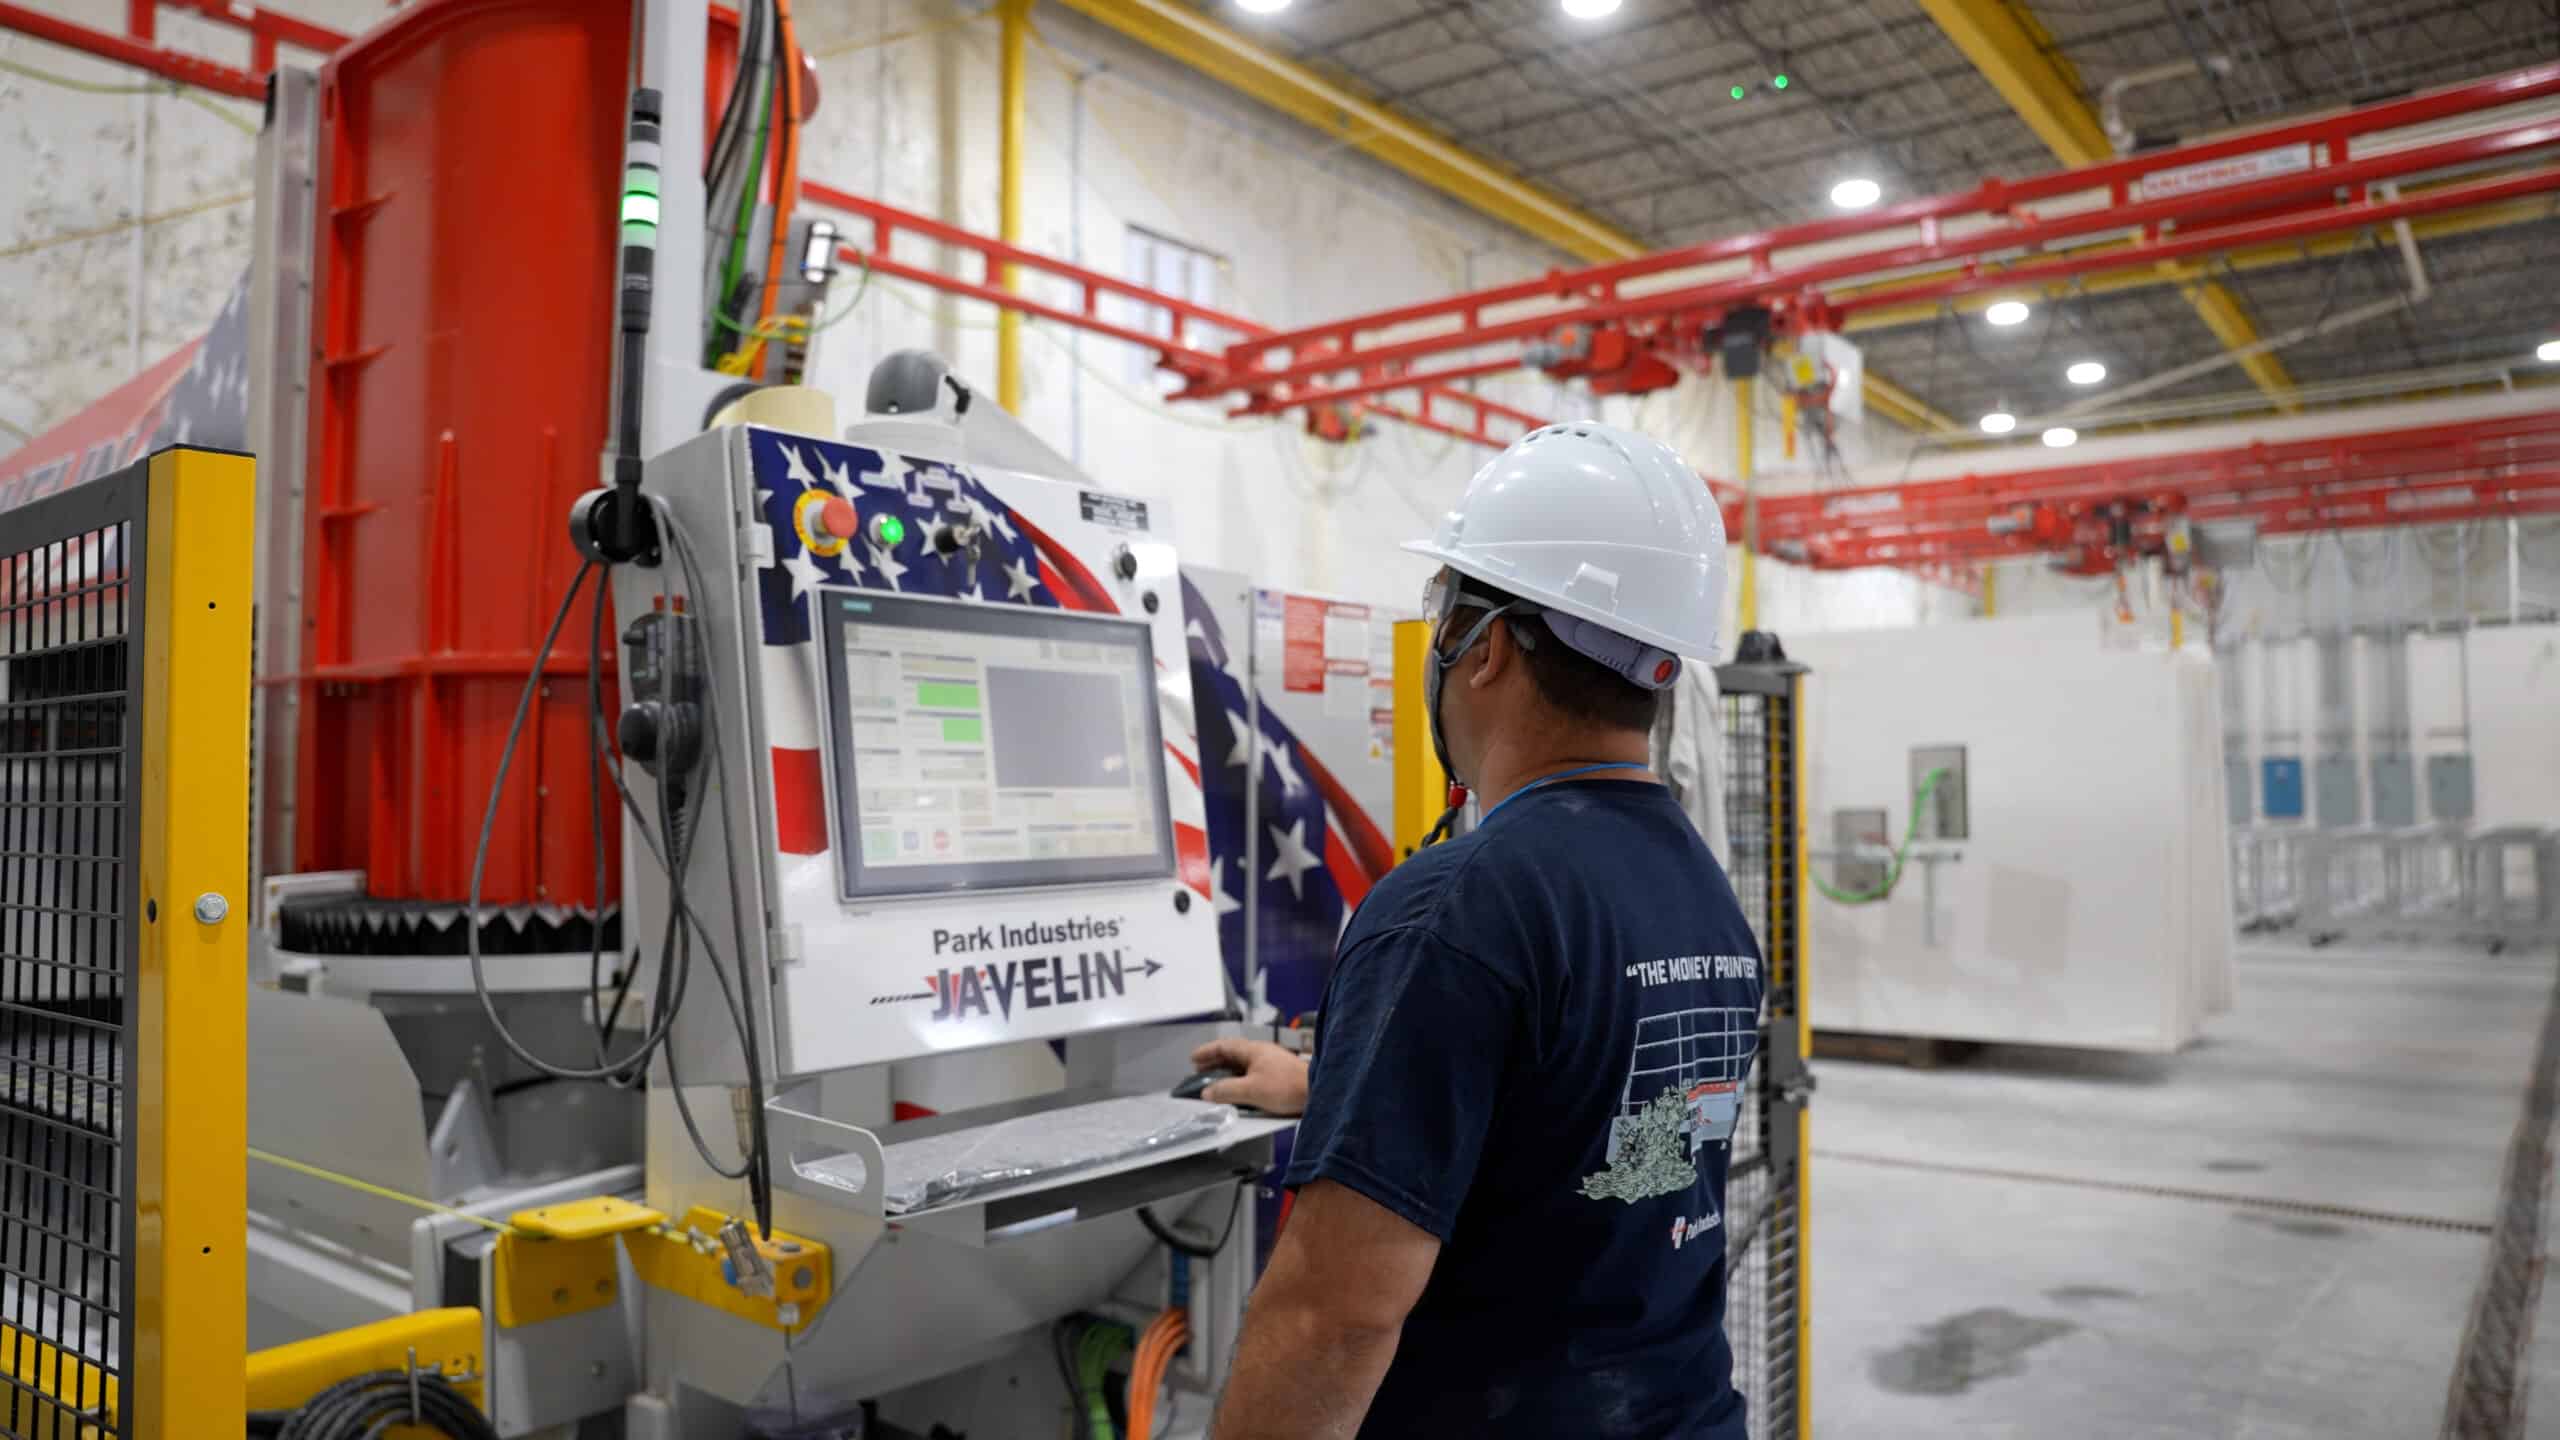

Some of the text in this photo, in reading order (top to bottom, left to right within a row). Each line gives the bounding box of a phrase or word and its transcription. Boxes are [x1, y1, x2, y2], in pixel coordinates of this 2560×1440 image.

[933, 916, 1119, 955] Park Industries
[932, 950, 1125, 1023] JAVELIN
[1668, 955, 1711, 982] MONEY
